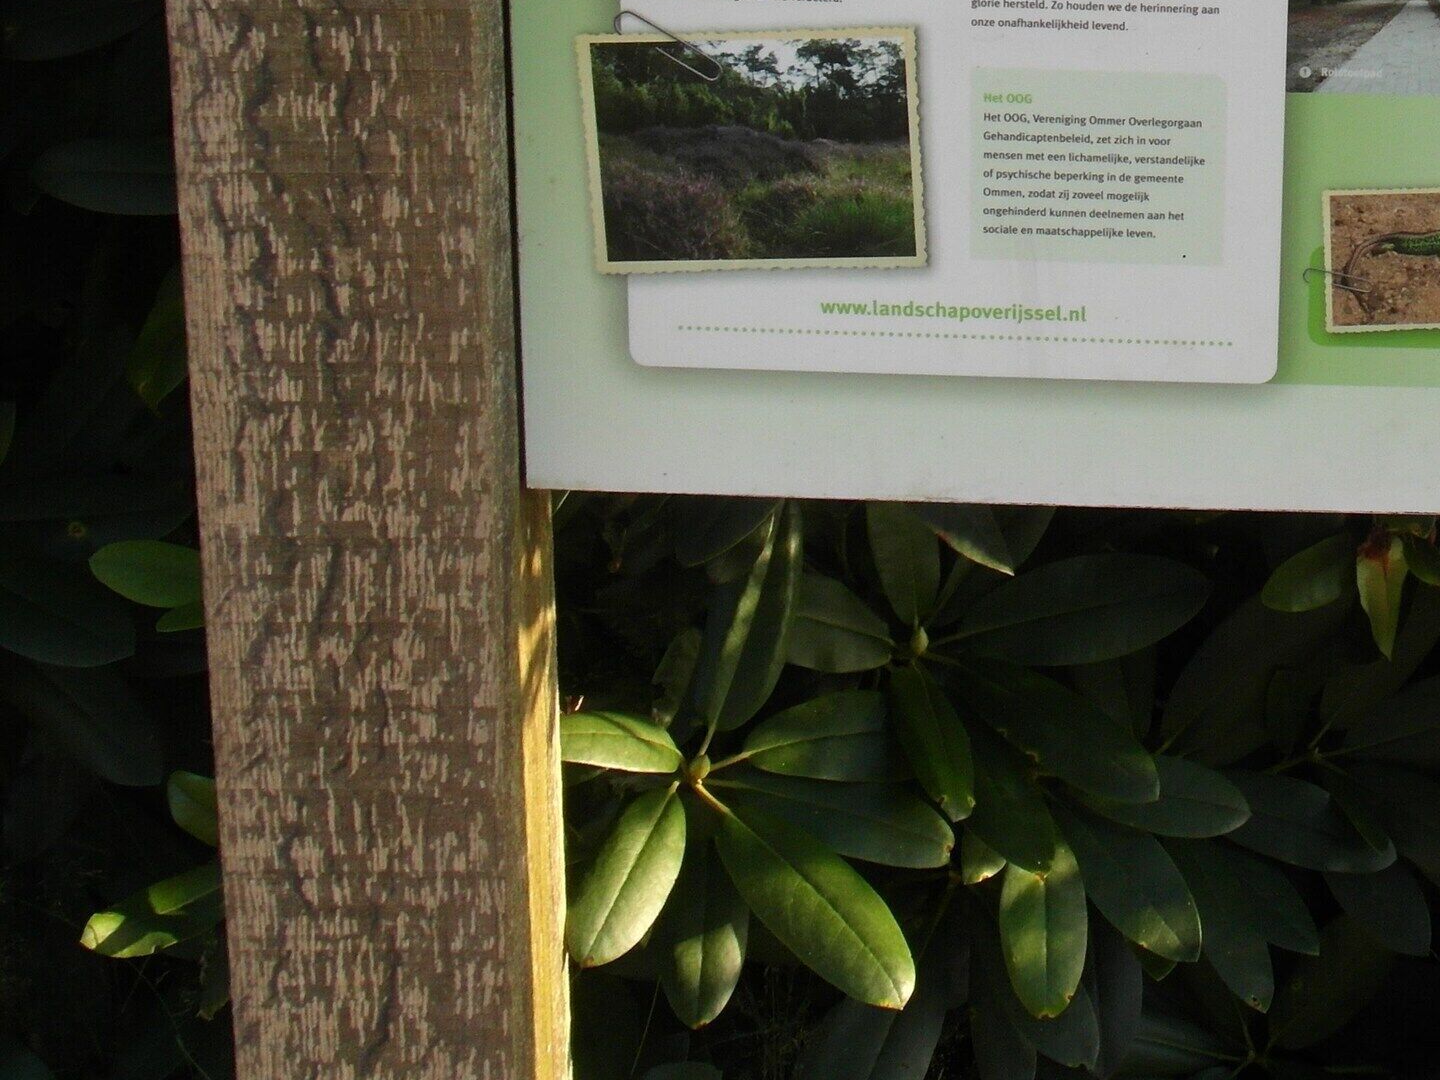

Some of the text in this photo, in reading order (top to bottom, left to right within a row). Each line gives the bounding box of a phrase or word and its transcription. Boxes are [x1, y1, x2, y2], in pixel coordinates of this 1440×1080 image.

[983, 93, 1032, 103] Het OOG
[984, 113, 1202, 129] Het OOG, Vereniging Ommer Overlegorgaan
[820, 300, 1086, 323] www.landschapoverijssel.nl
